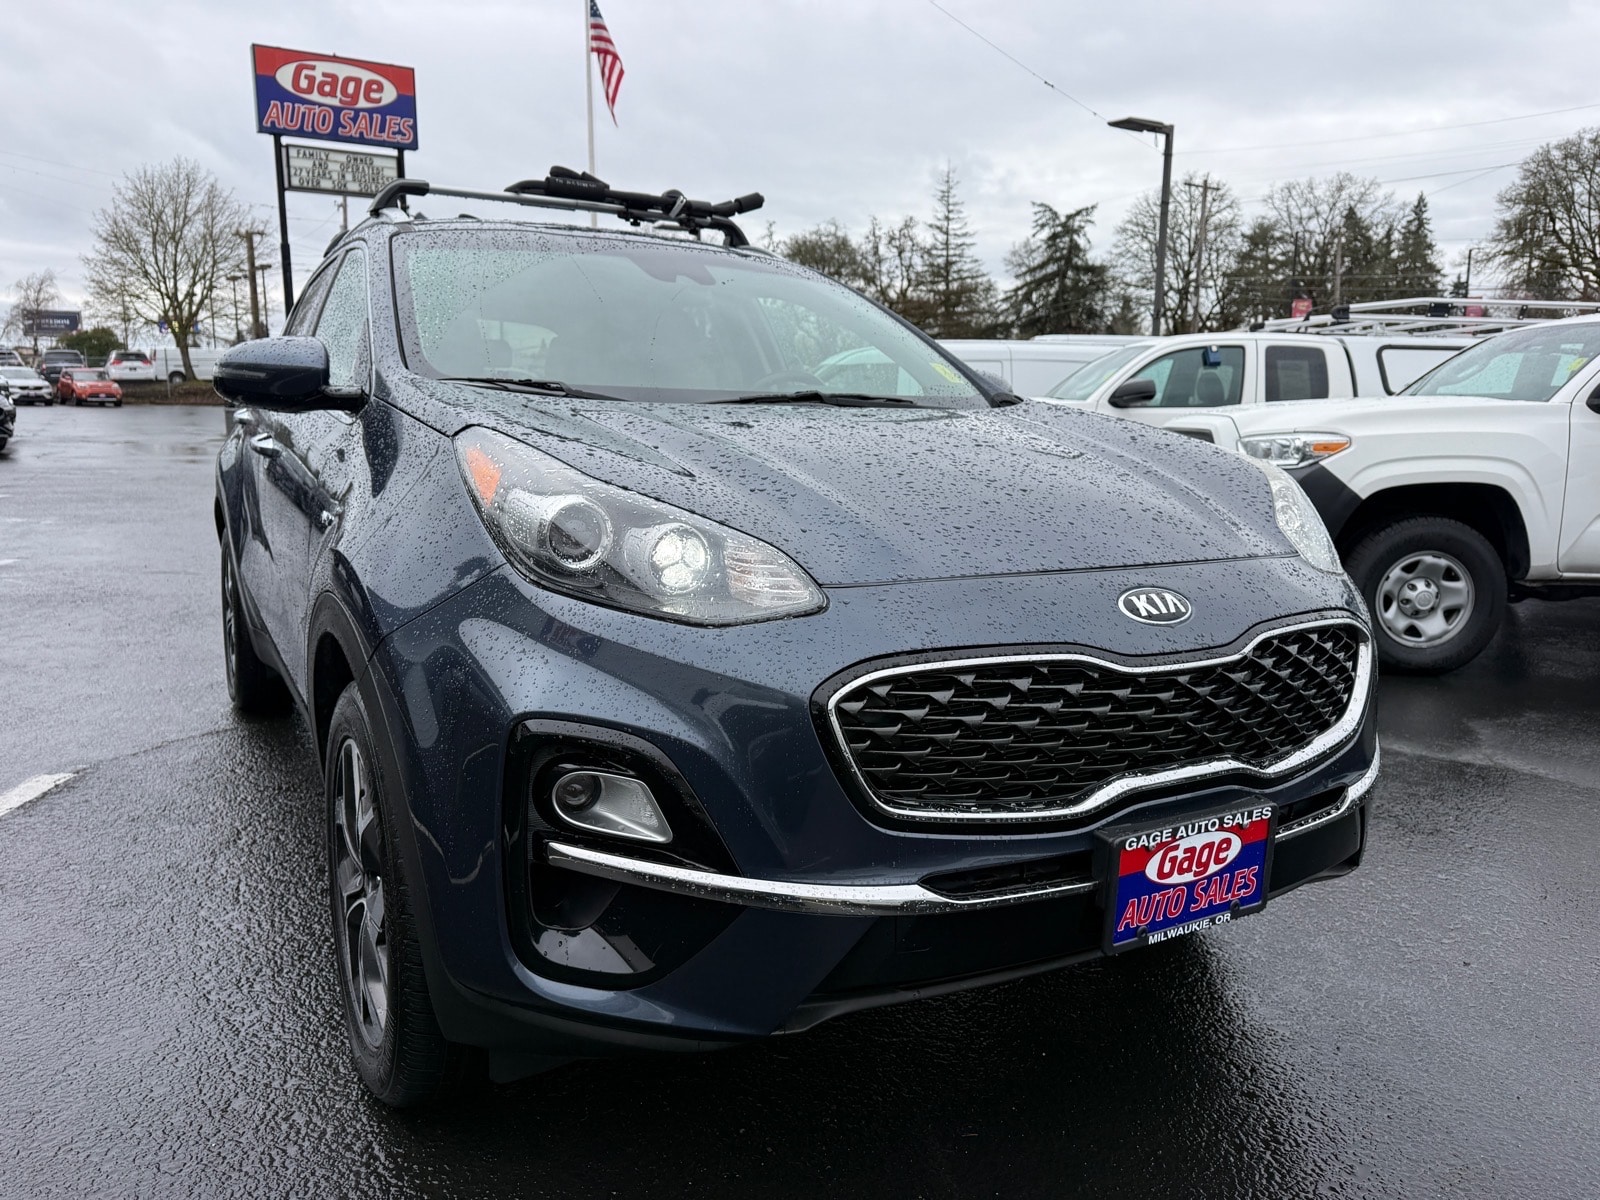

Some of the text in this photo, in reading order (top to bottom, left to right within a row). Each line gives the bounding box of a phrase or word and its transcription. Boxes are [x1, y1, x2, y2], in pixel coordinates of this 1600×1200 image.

[291, 63, 384, 107] Gage
[263, 100, 414, 143] AUTO SALES
[296, 149, 374, 166] FAMILY OWNED
[312, 160, 329, 170] AND
[293, 168, 303, 177] 27
[305, 168, 333, 180] YEARS
[337, 172, 346, 181] IN
[299, 177, 321, 188] OVER
[1128, 592, 1187, 617] KIA
[1125, 806, 1272, 852] GAGE AUTO SALES
[1156, 837, 1233, 880] Gage
[1117, 866, 1258, 932] AUTO SALES
[1215, 913, 1231, 925] OR
